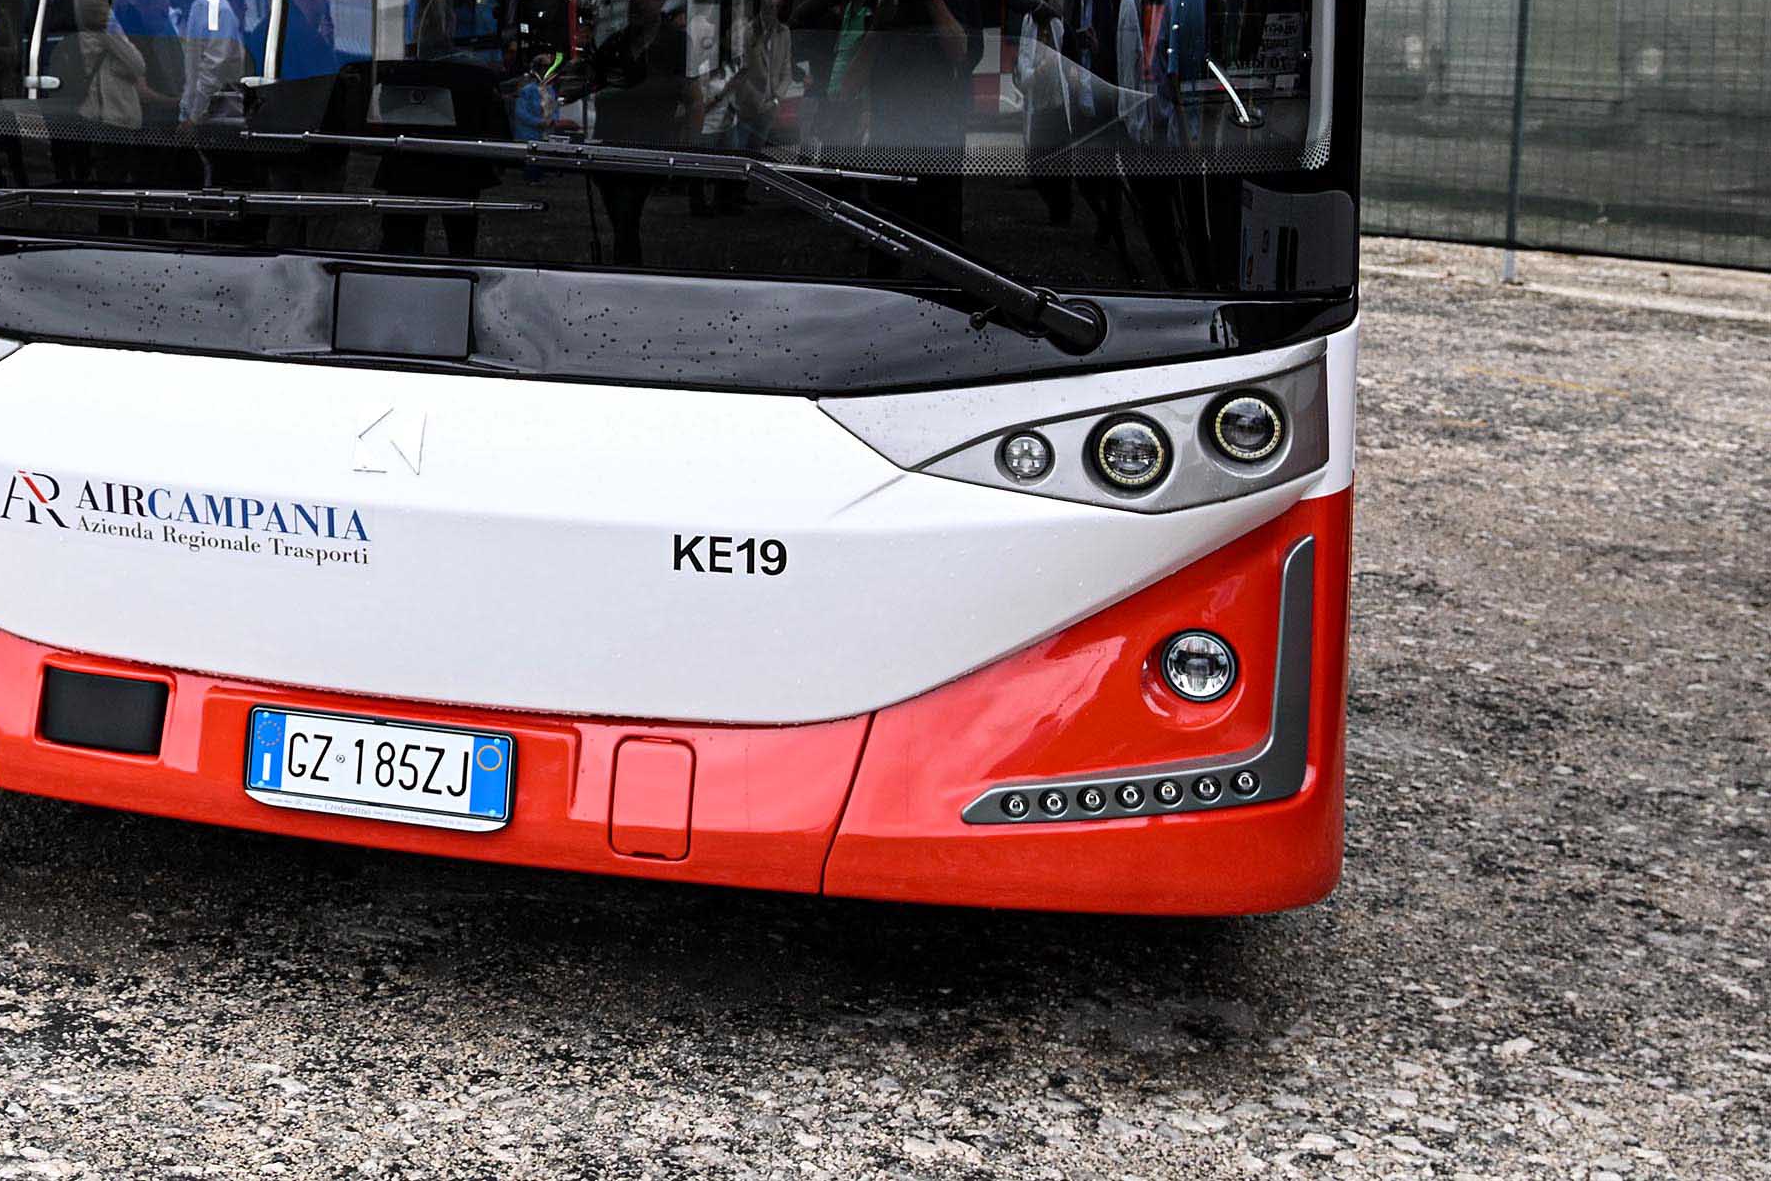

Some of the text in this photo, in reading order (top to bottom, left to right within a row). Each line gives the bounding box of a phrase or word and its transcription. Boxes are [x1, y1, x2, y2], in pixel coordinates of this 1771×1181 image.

[76, 479, 372, 543] AIRCAMPANIA
[77, 515, 370, 566] Azienda Regionale Trasporti
[673, 534, 788, 576] KE19
[287, 732, 470, 797] GZ 185ZJ
